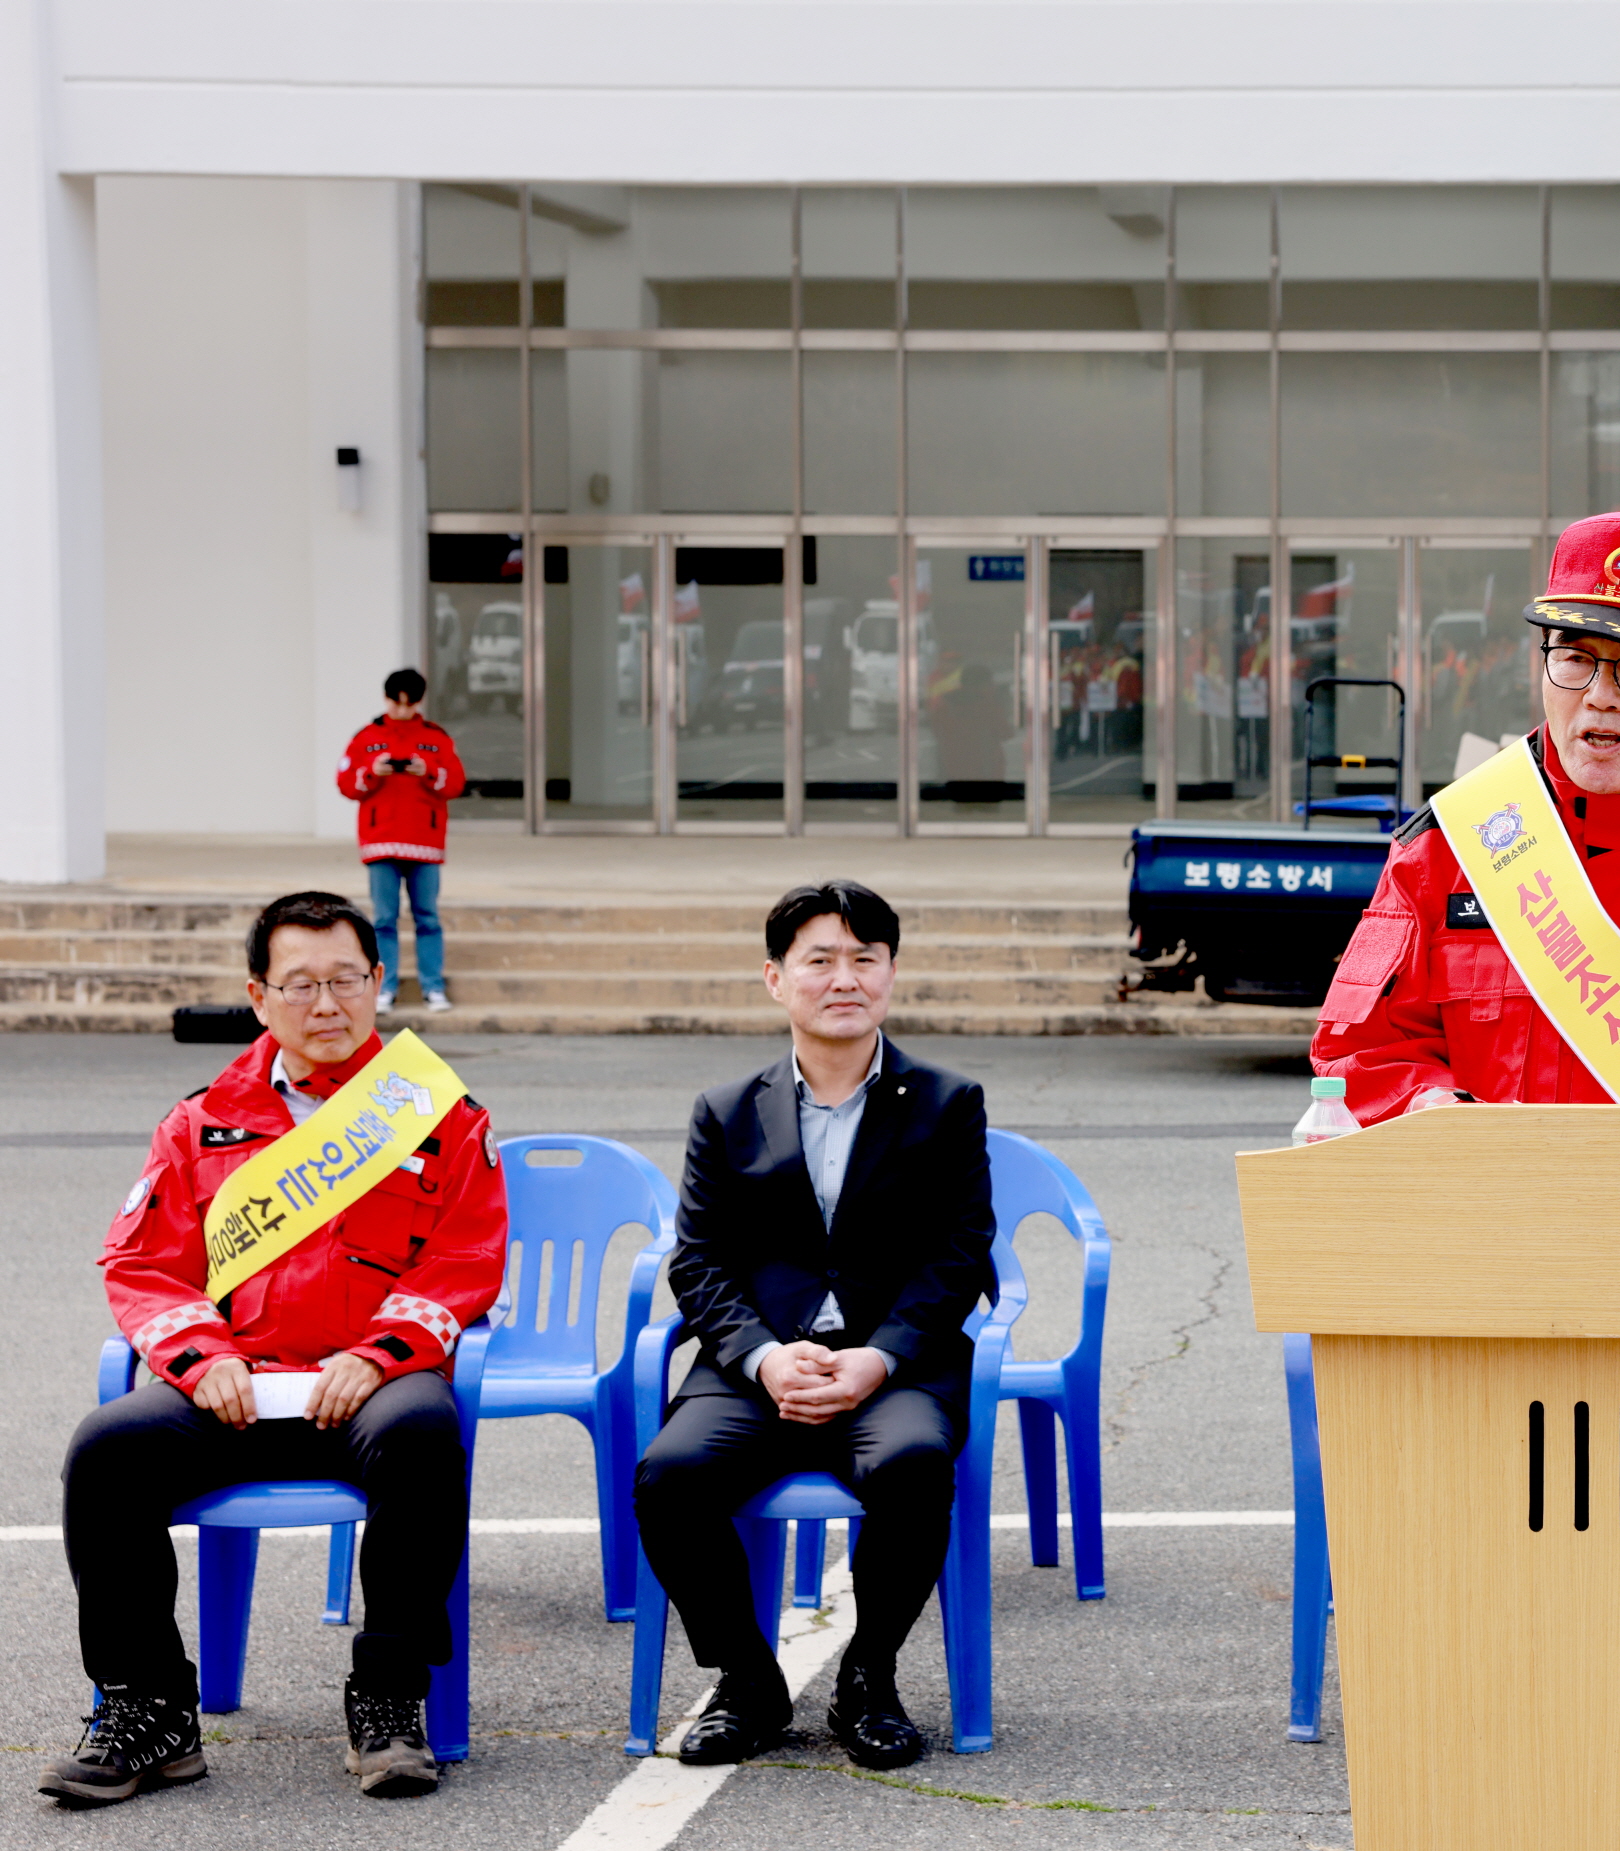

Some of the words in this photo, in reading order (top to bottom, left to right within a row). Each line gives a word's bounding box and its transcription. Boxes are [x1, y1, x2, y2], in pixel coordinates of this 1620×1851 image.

[1492, 835, 1537, 873] 보령소방서
[1184, 861, 1334, 892] 보령소방서
[276, 1108, 397, 1211] 품격있는
